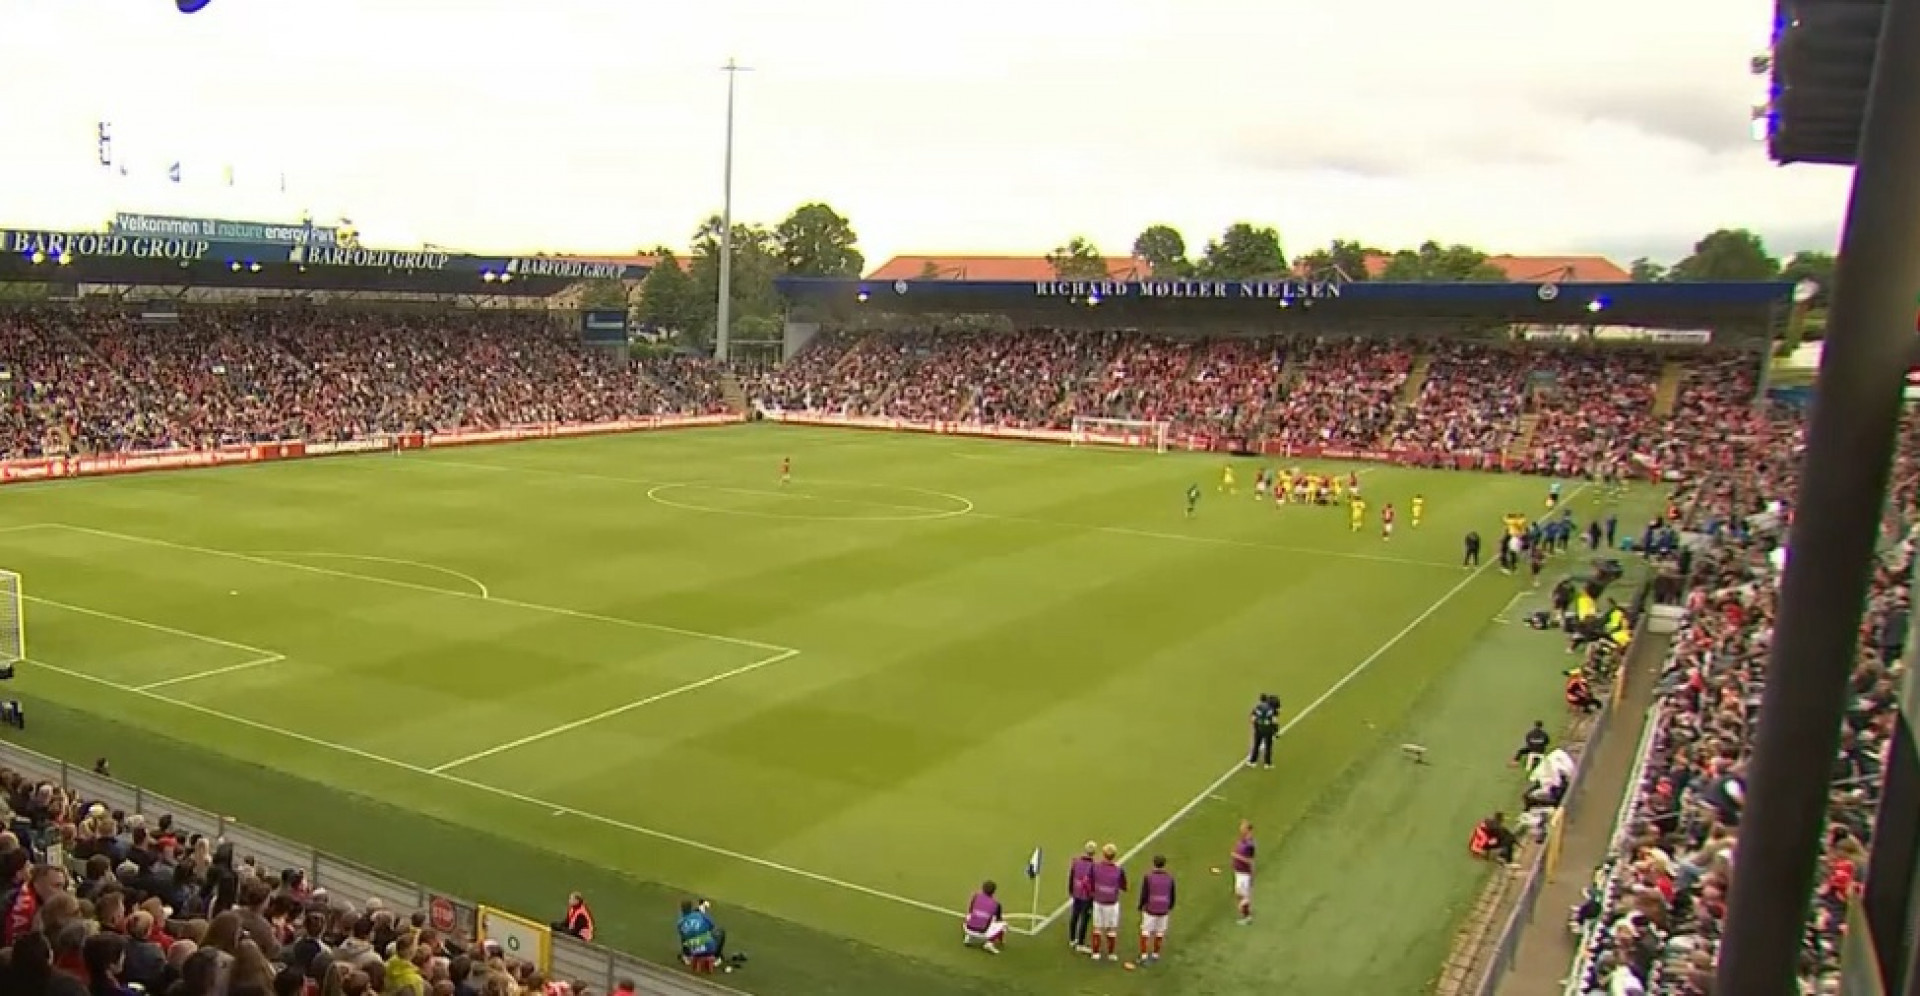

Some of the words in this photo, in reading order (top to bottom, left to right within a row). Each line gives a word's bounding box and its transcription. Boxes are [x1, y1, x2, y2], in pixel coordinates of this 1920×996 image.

[119, 215, 198, 234] Velkommen
[202, 219, 216, 235] til
[218, 223, 263, 238] nature
[14, 232, 127, 256] BARFOED
[133, 238, 209, 260] GROUP
[308, 247, 389, 267] BARFOED
[392, 253, 450, 270] GROUP
[1036, 281, 1128, 296] RICHARD
[1240, 282, 1340, 298] NIELSEN
